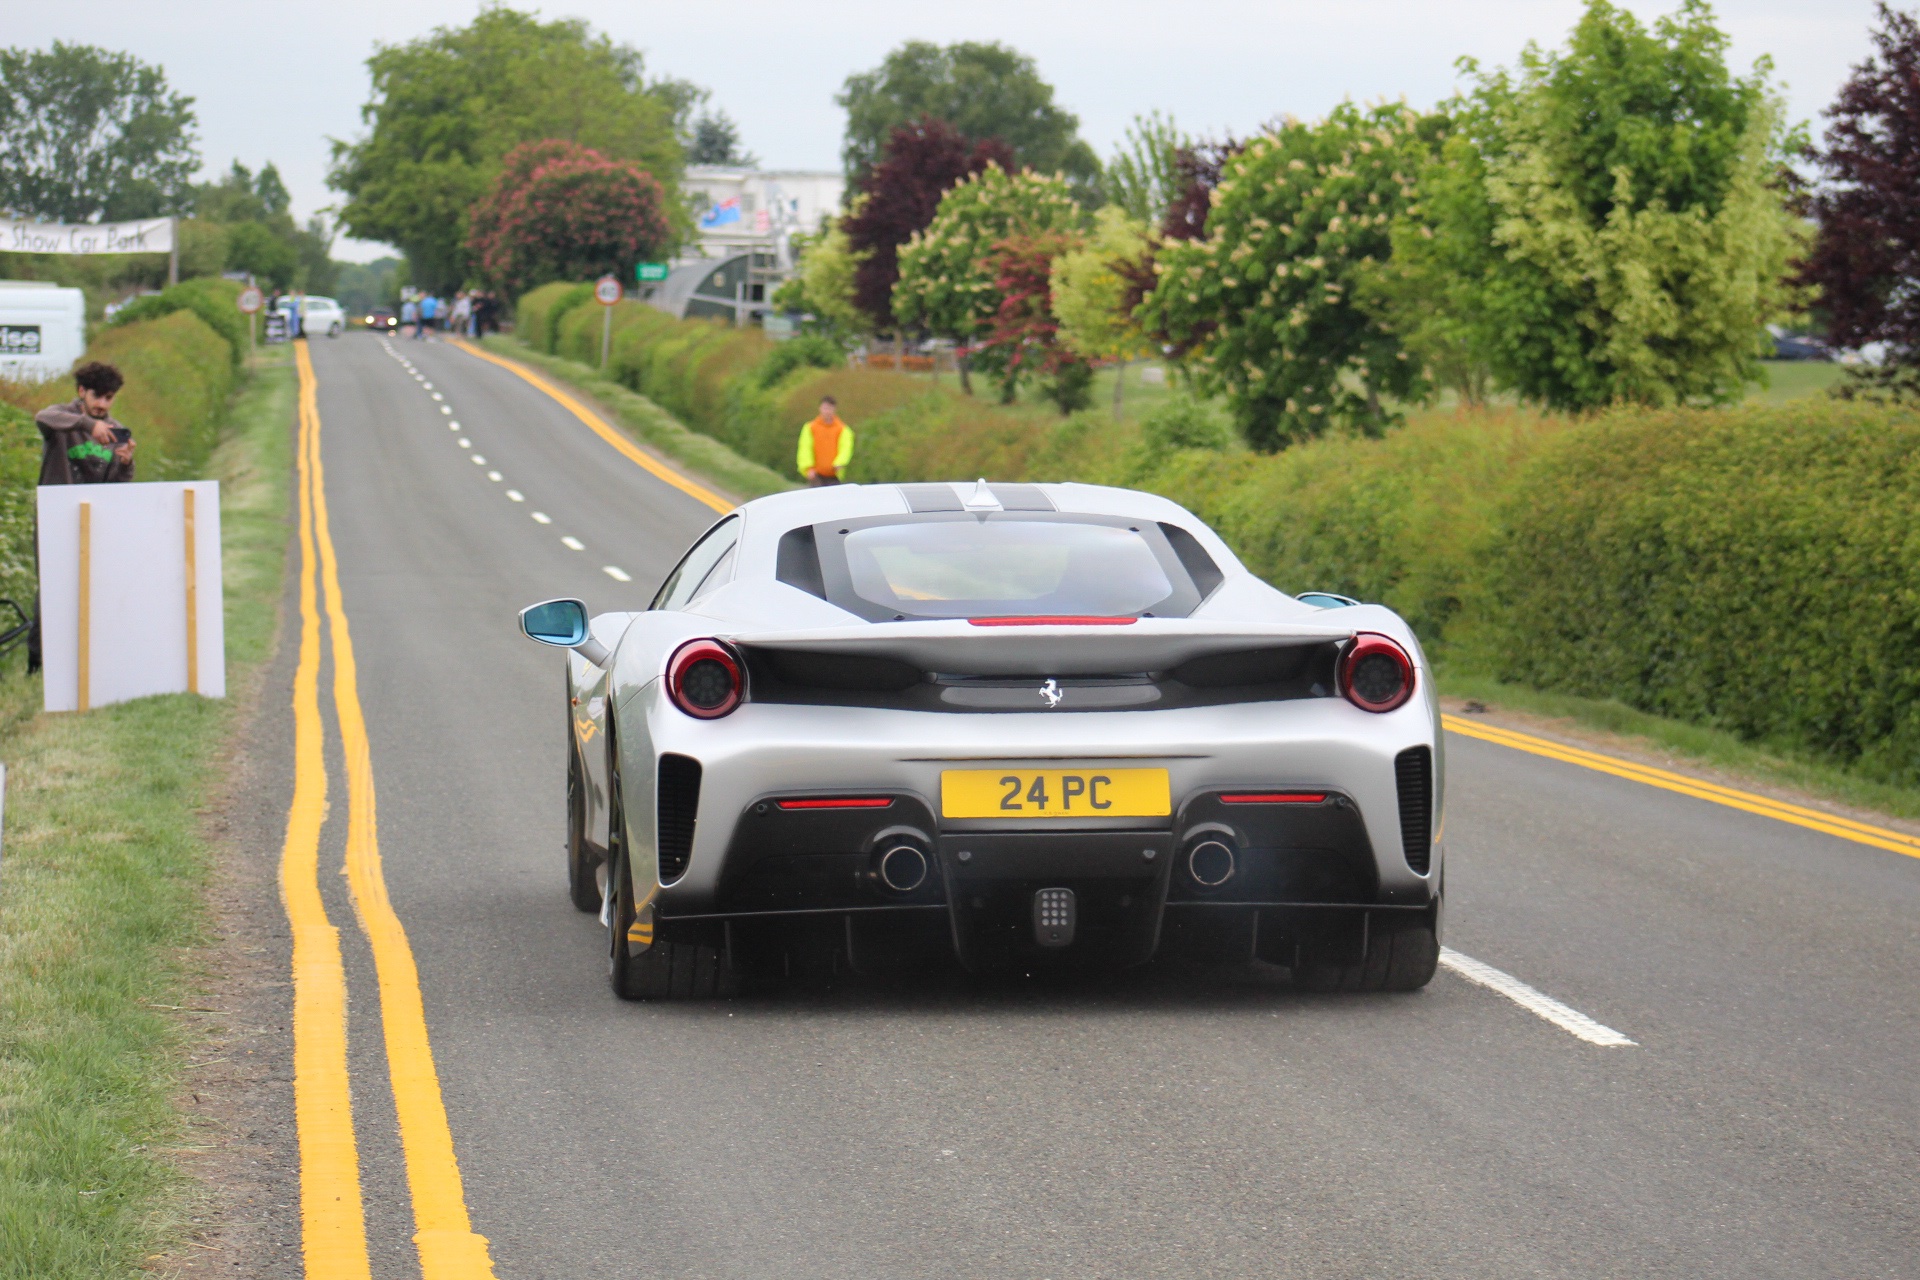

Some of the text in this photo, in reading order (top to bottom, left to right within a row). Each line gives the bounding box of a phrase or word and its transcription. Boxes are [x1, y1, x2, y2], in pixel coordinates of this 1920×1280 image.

[12, 224, 60, 250] Show
[69, 227, 98, 250] Car
[107, 224, 148, 249] Park
[999, 775, 1112, 810] 24 PC
